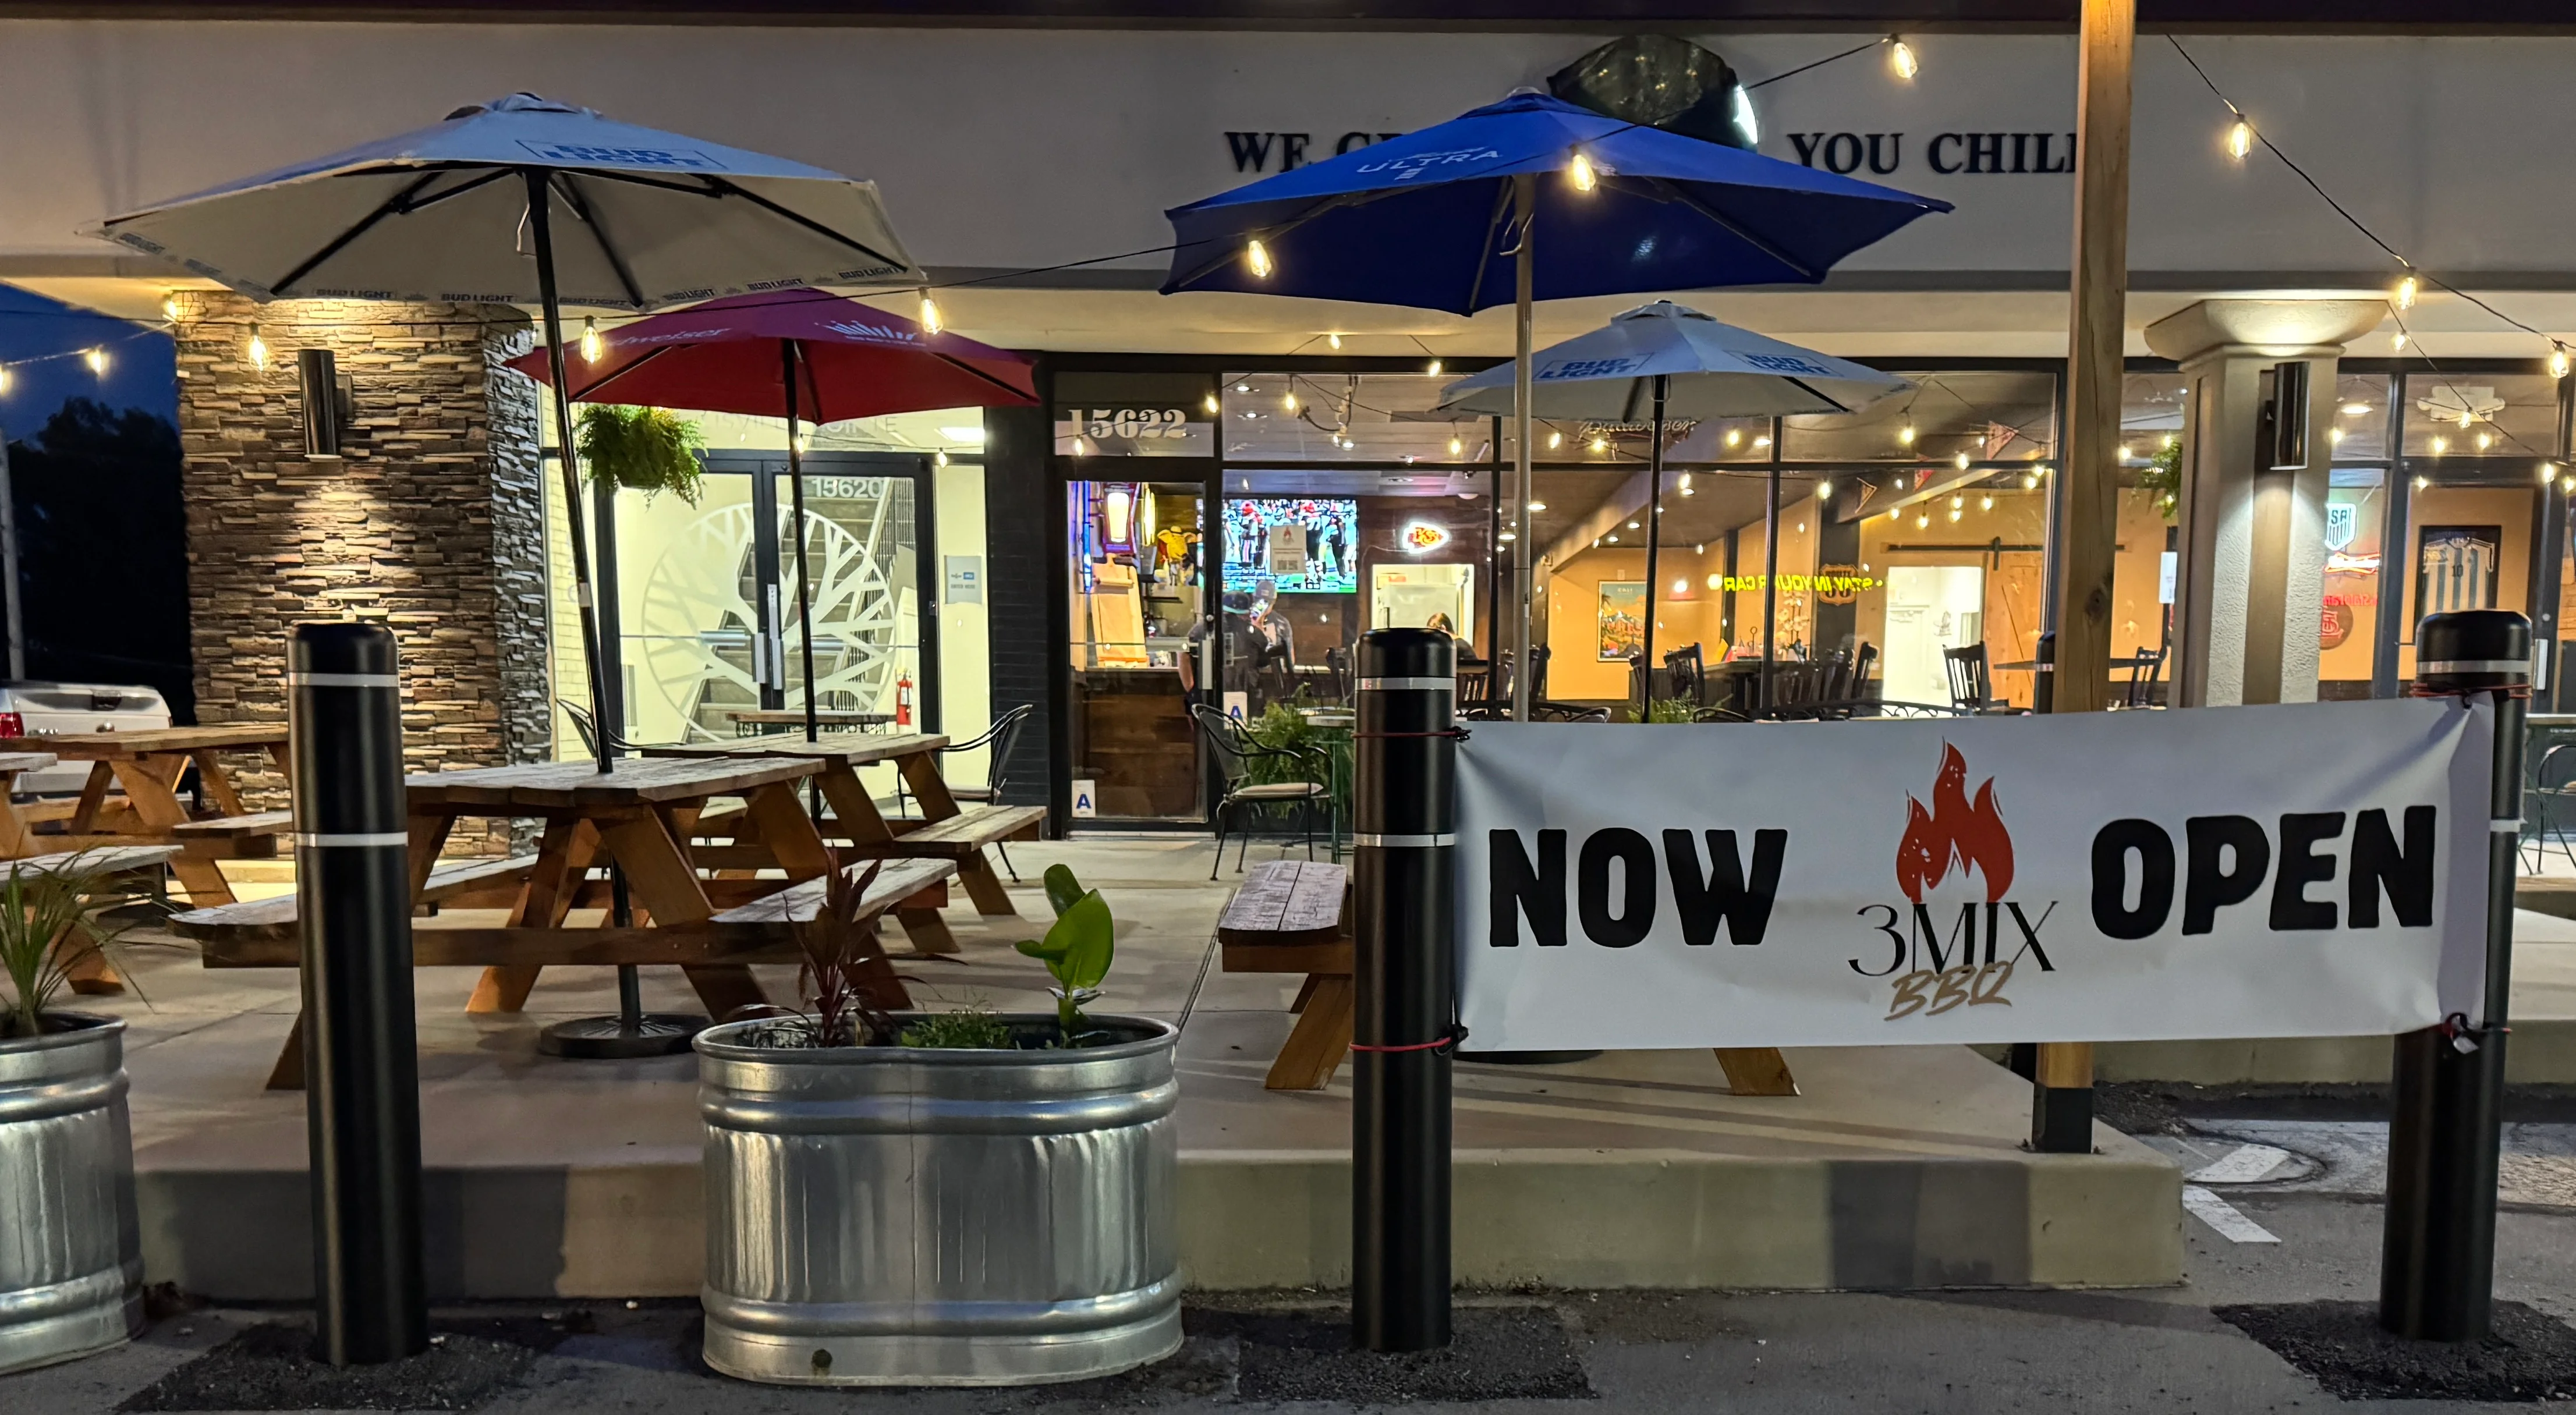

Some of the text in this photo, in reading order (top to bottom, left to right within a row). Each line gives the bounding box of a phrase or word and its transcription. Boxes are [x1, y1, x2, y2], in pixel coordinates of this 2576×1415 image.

[1225, 132, 1309, 173] WE
[1356, 150, 1498, 173] ULTRA
[1787, 133, 1904, 174] YOU
[747, 278, 804, 291] BUD LIGHT
[441, 293, 514, 303] BUD LIGHT
[1540, 364, 1636, 378] LIGHT
[1562, 358, 1631, 371] BUD
[1068, 409, 1188, 438] 15622
[811, 477, 884, 498] 15620
[2452, 563, 2464, 577] 10
[1229, 705, 1243, 722] A
[1076, 793, 1092, 809] A
[1489, 805, 2437, 948] NOW OPEN
[1848, 900, 2059, 977] 3MIX
[1884, 960, 2014, 1022] BBQ
